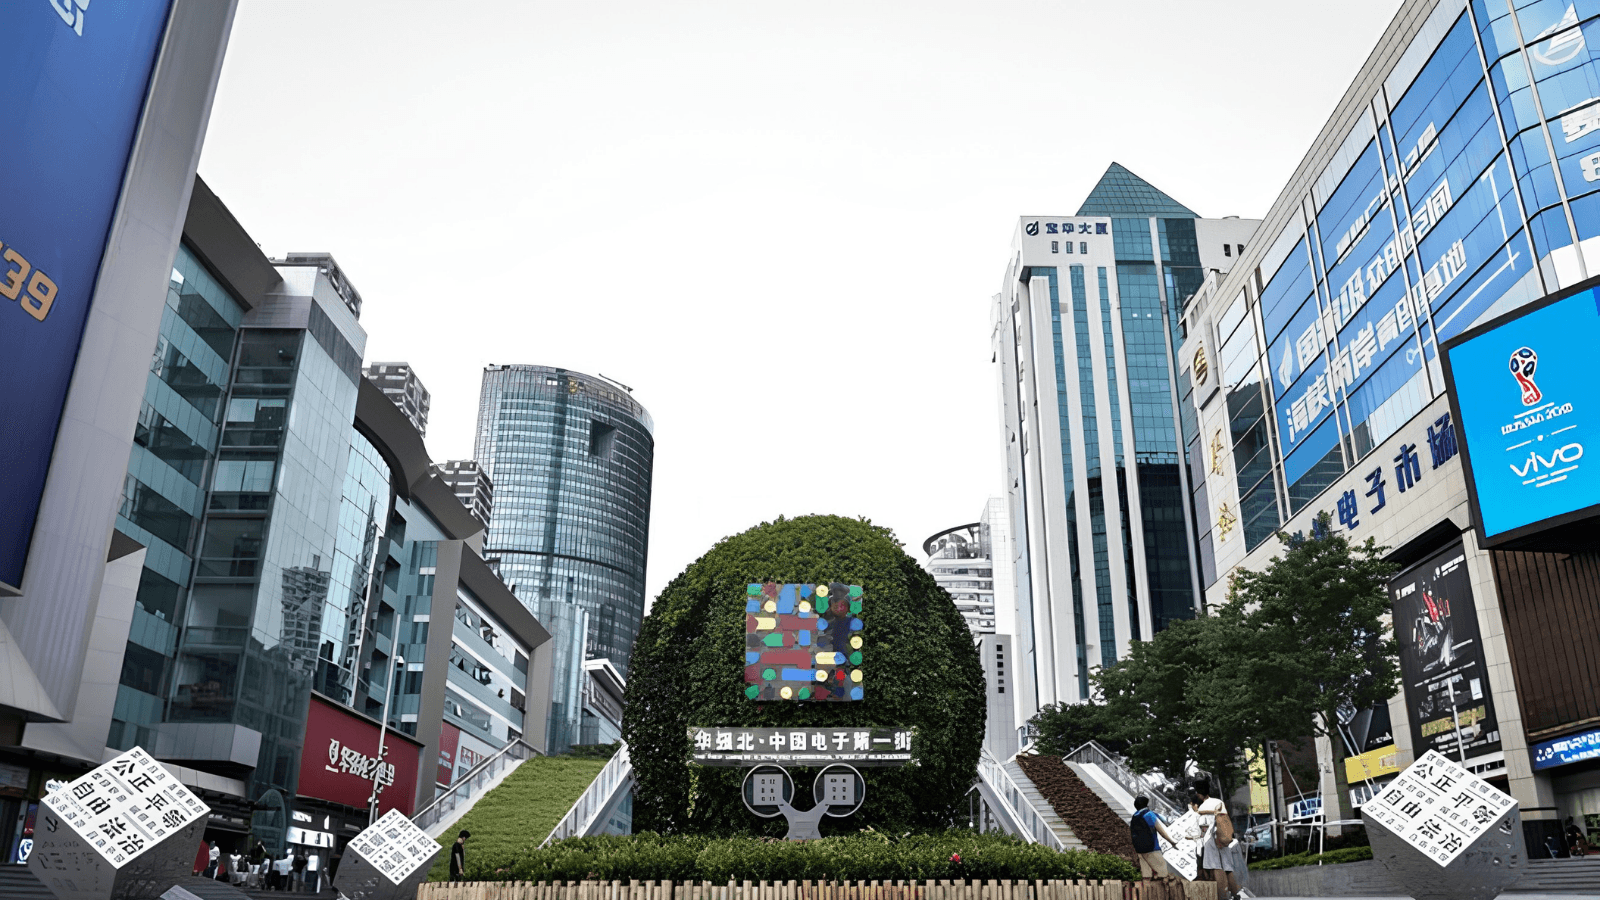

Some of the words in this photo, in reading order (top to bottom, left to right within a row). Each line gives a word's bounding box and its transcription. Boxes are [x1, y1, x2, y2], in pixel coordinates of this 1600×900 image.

[0, 242, 58, 321] 39
[1312, 412, 1459, 540] 电子市场
[1509, 443, 1583, 477] vivo
